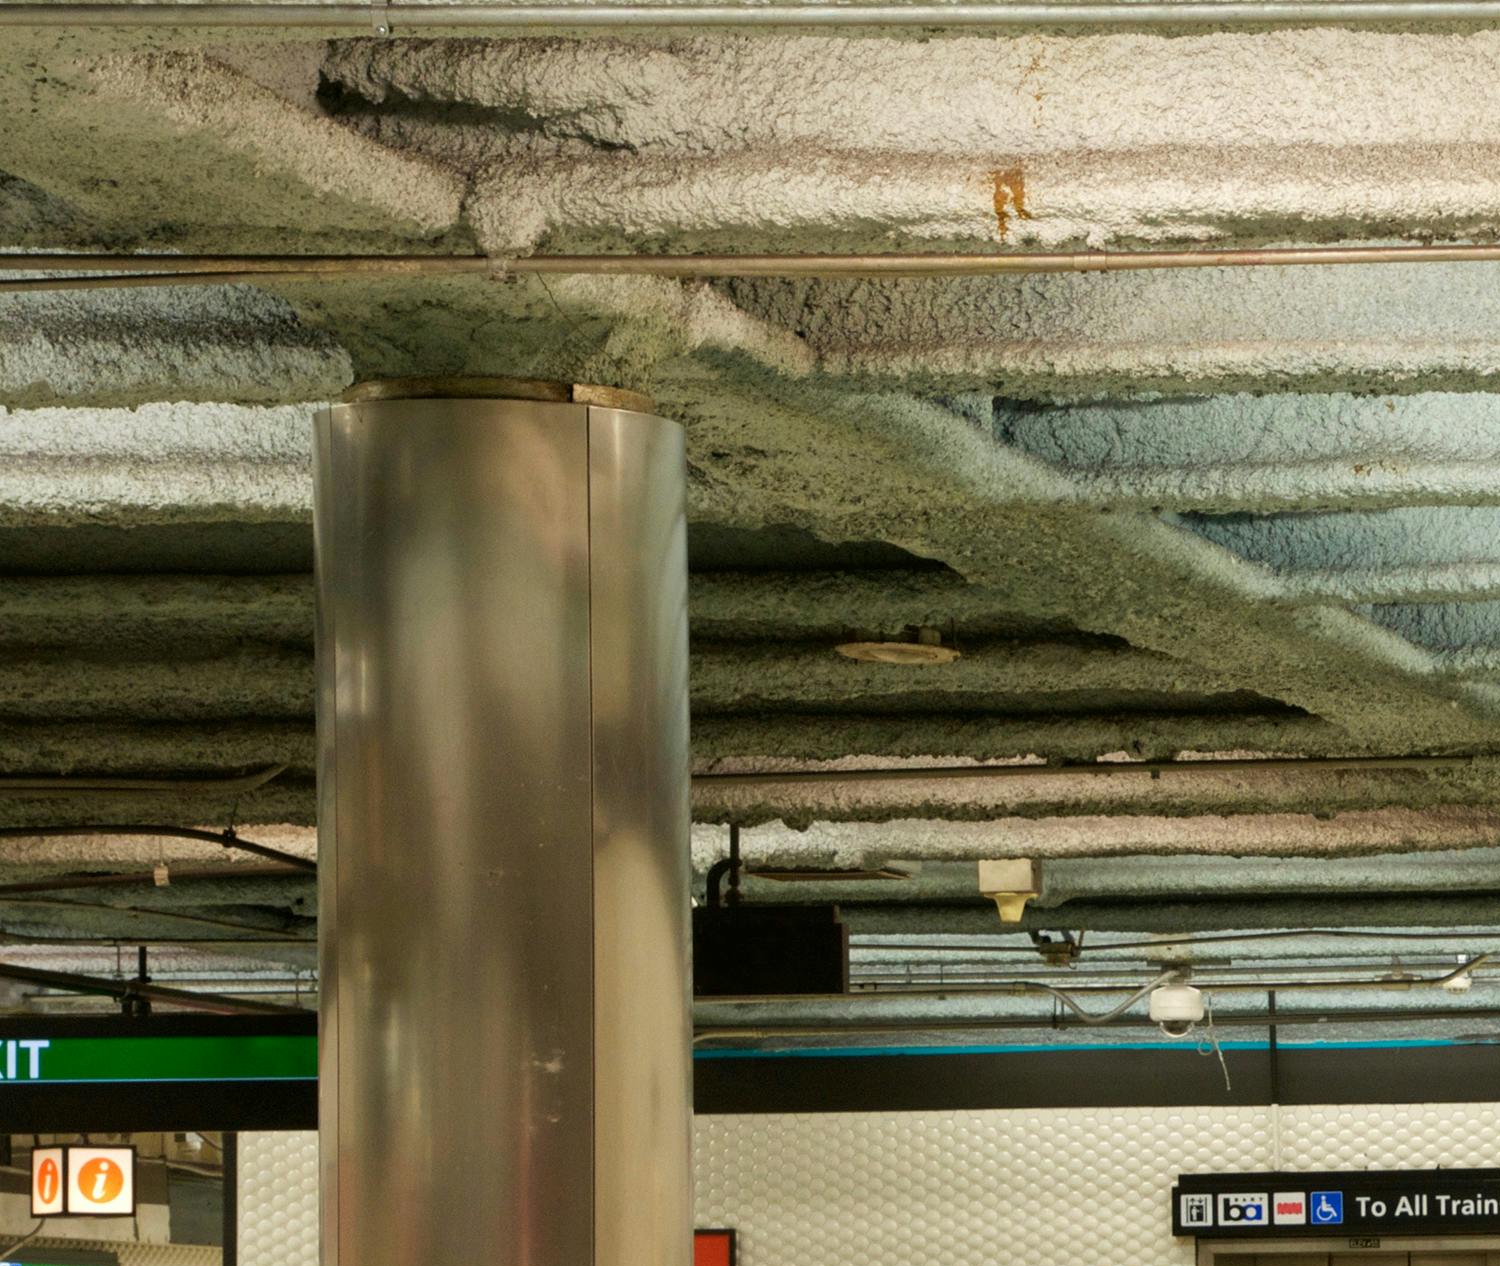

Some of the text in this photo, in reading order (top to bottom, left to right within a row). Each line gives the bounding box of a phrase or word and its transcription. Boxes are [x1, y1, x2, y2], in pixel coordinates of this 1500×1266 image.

[0, 1040, 50, 1079] IT
[1355, 1196, 1387, 1217] To
[1394, 1194, 1428, 1216] All
